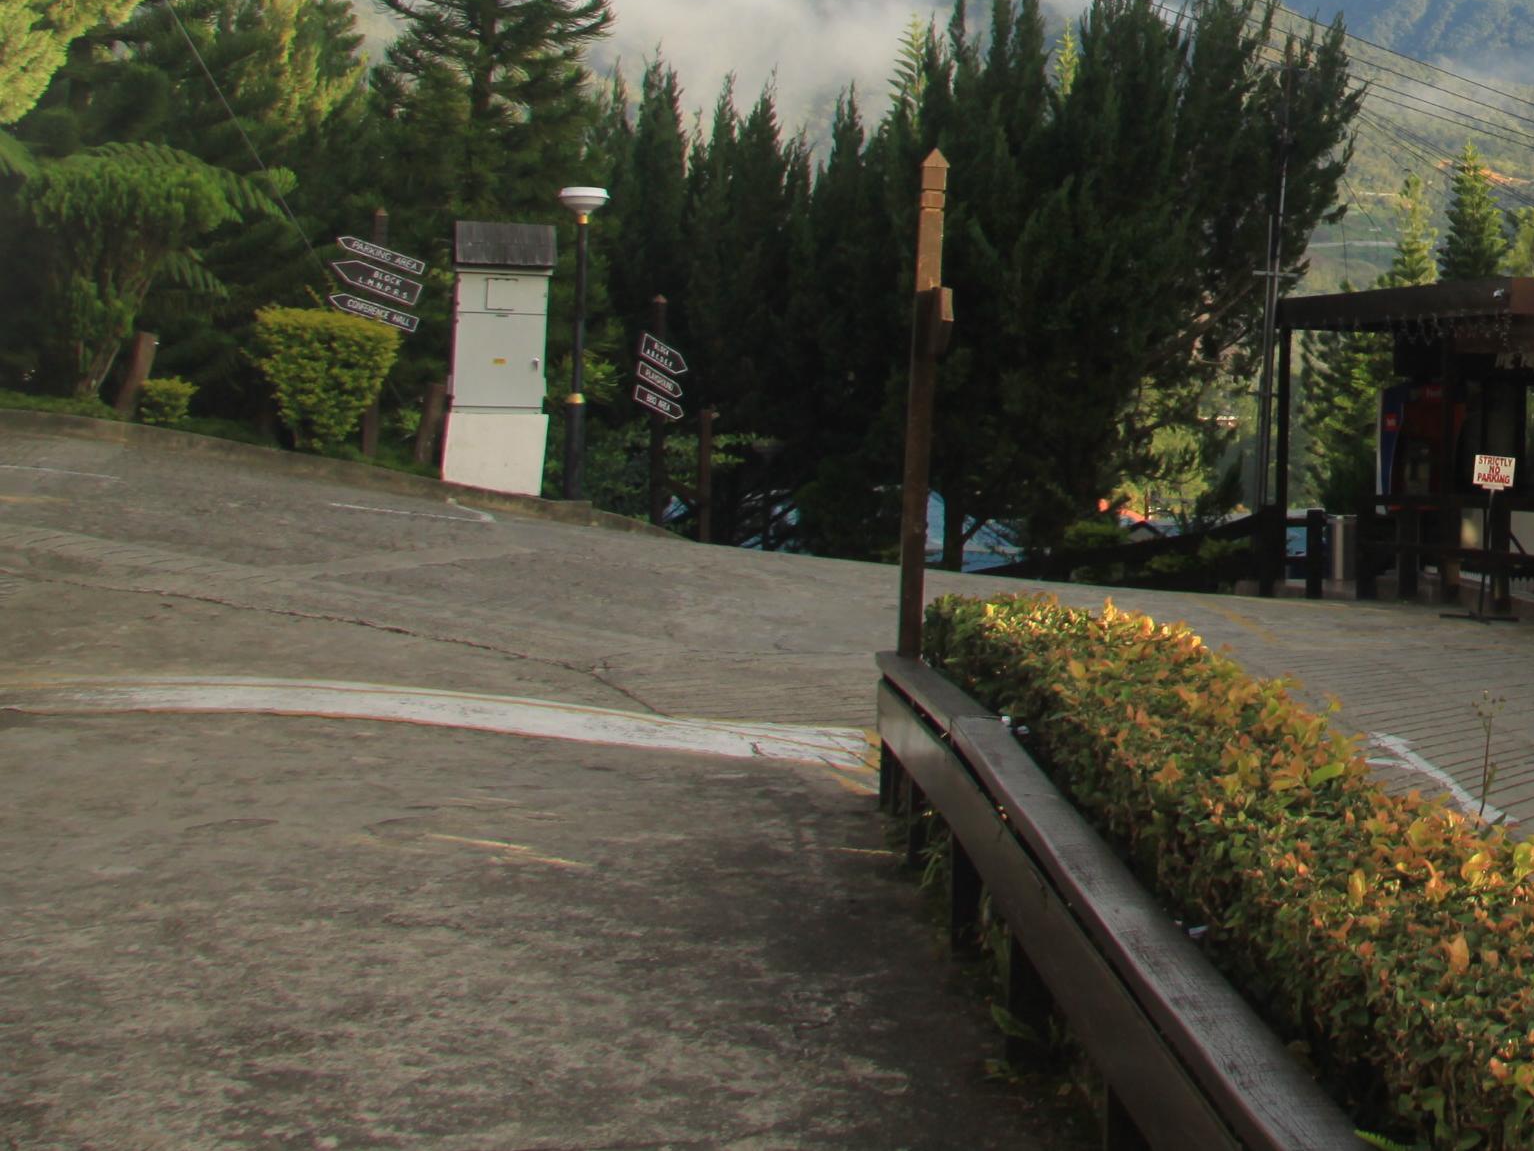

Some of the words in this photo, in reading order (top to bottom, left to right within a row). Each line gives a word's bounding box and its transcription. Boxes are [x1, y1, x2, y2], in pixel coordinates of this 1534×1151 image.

[351, 241, 392, 261] PARKING
[394, 257, 417, 270] AREA
[373, 271, 402, 286] BLOCK
[347, 299, 391, 319] CONFERENCE
[392, 314, 410, 326] HALL
[1478, 456, 1513, 467] STRICTLY
[1489, 466, 1501, 475] NO
[1477, 473, 1510, 484] PARKING
